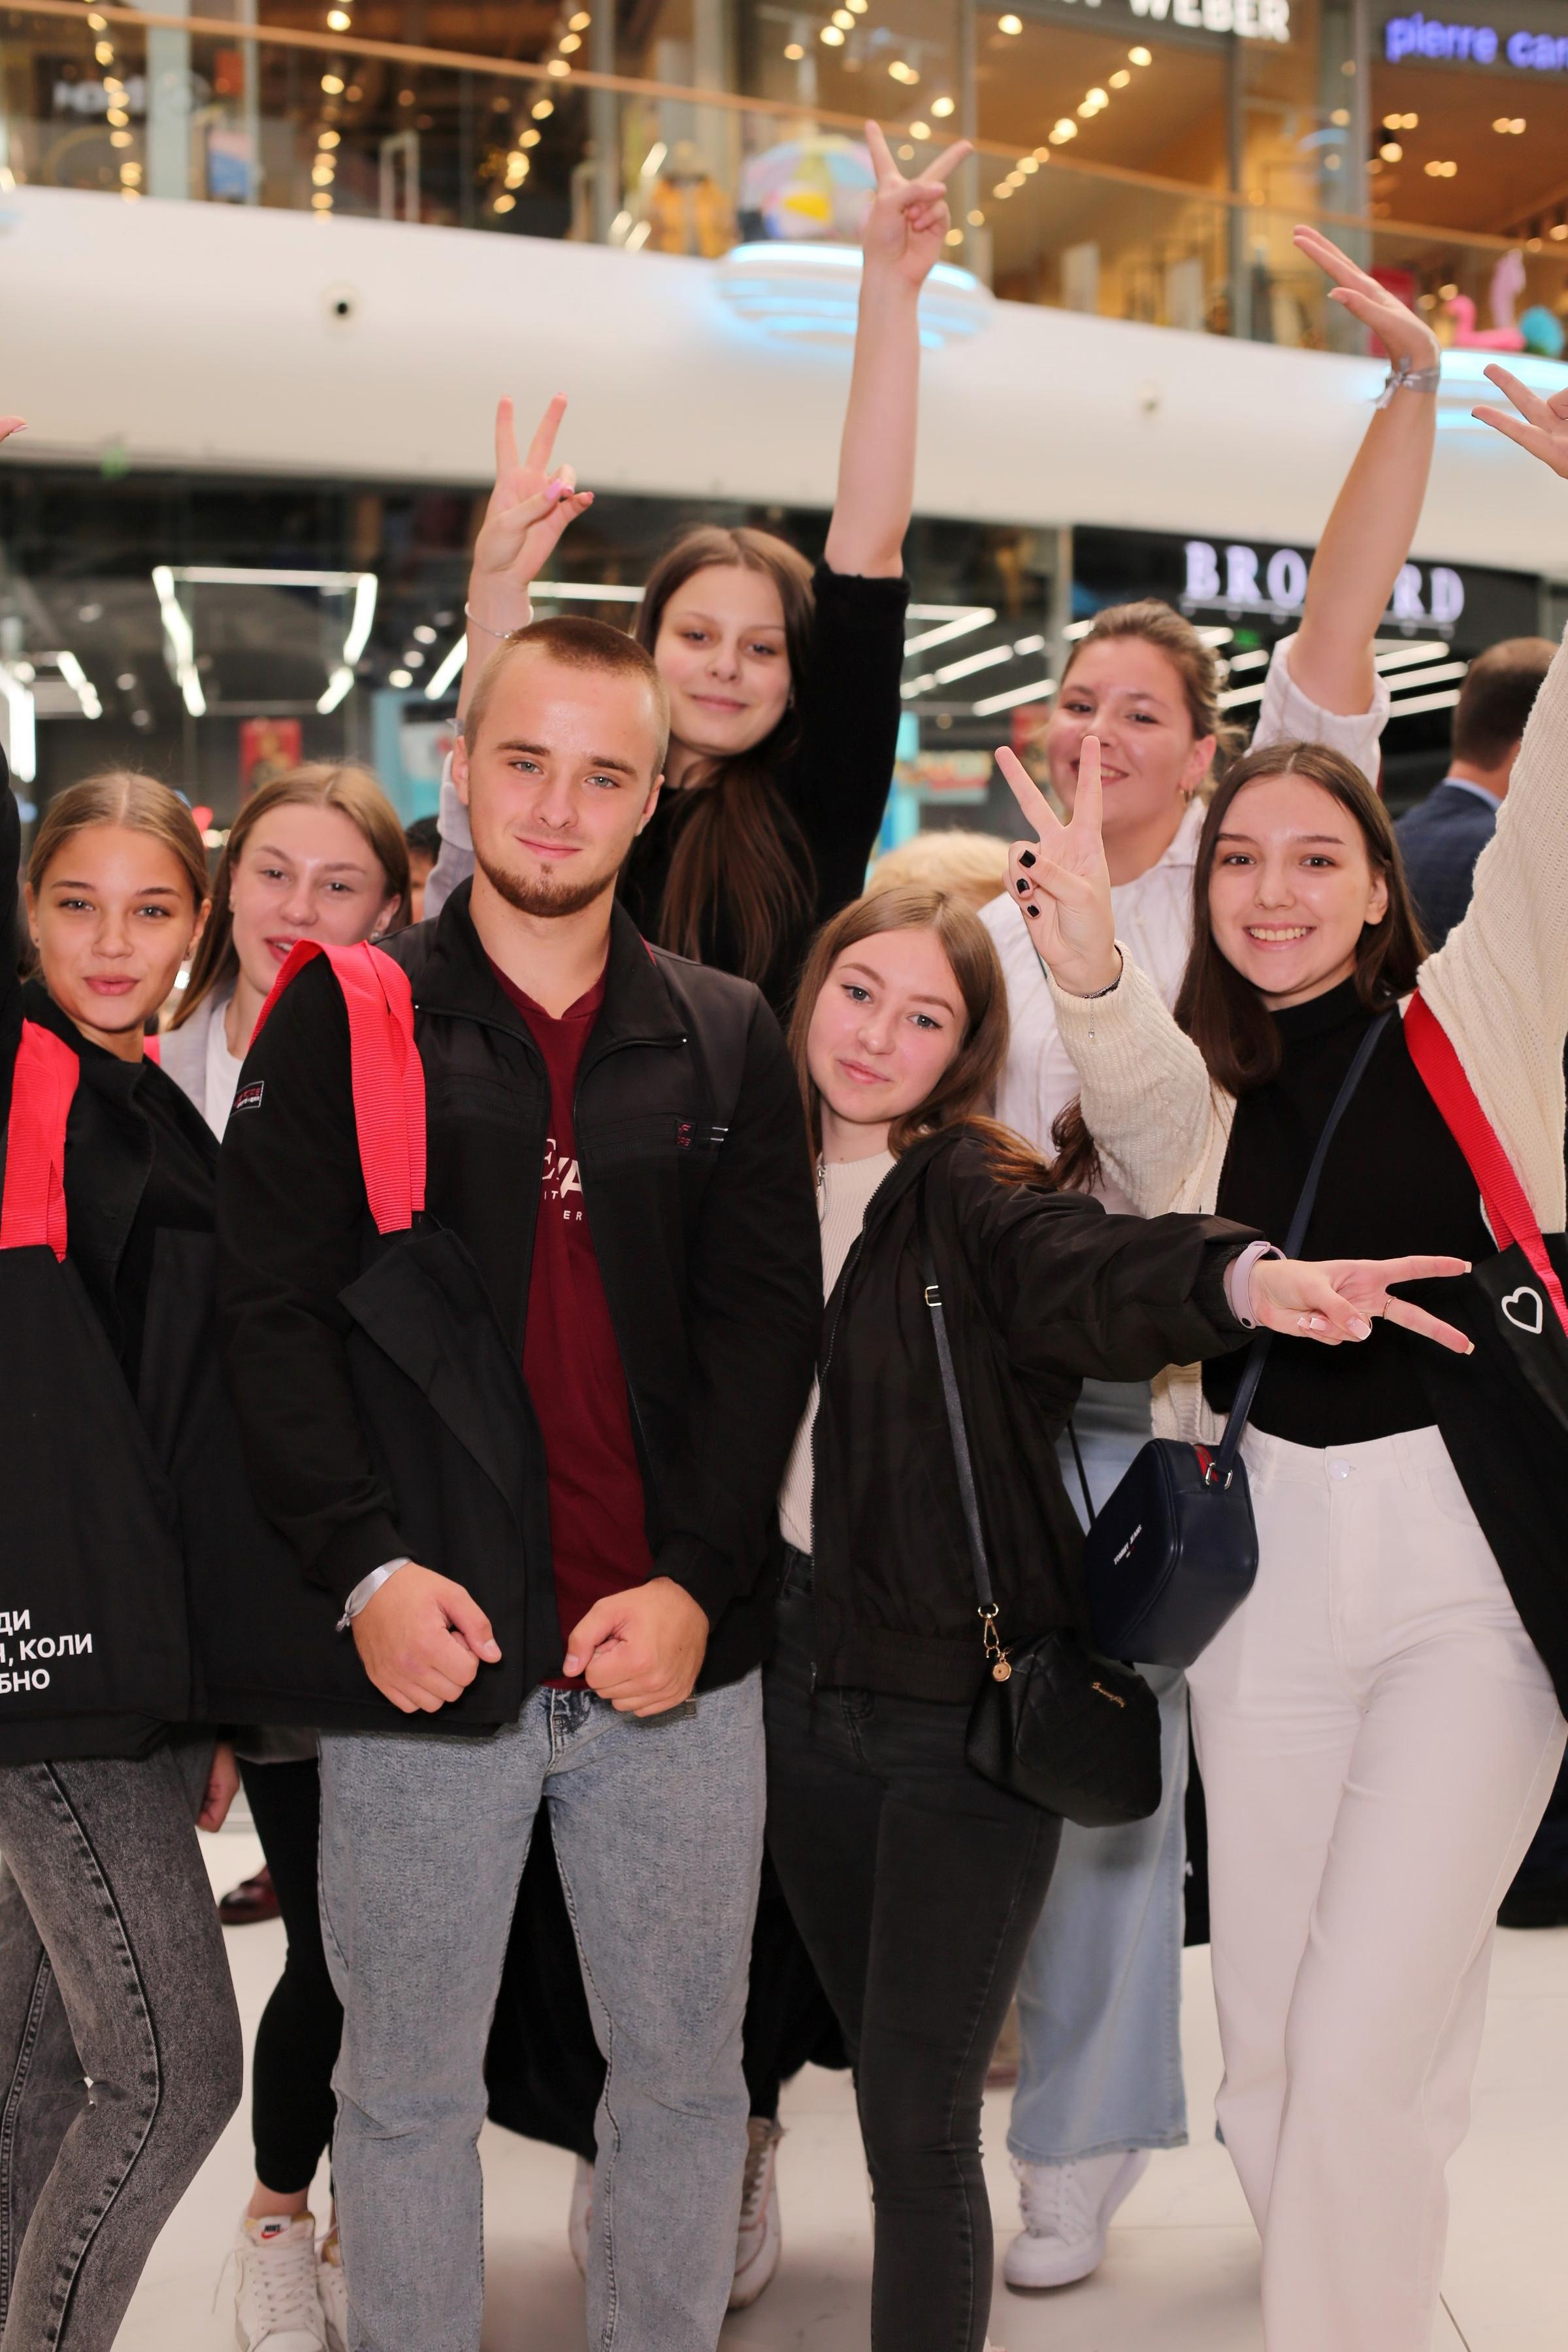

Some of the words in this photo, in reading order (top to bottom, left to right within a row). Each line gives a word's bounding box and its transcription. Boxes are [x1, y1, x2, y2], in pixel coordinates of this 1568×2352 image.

[1385, 11, 1498, 63] pierre
[1184, 540, 1465, 623] BRORD
[20, 1633, 93, 1661] КОЛИ
